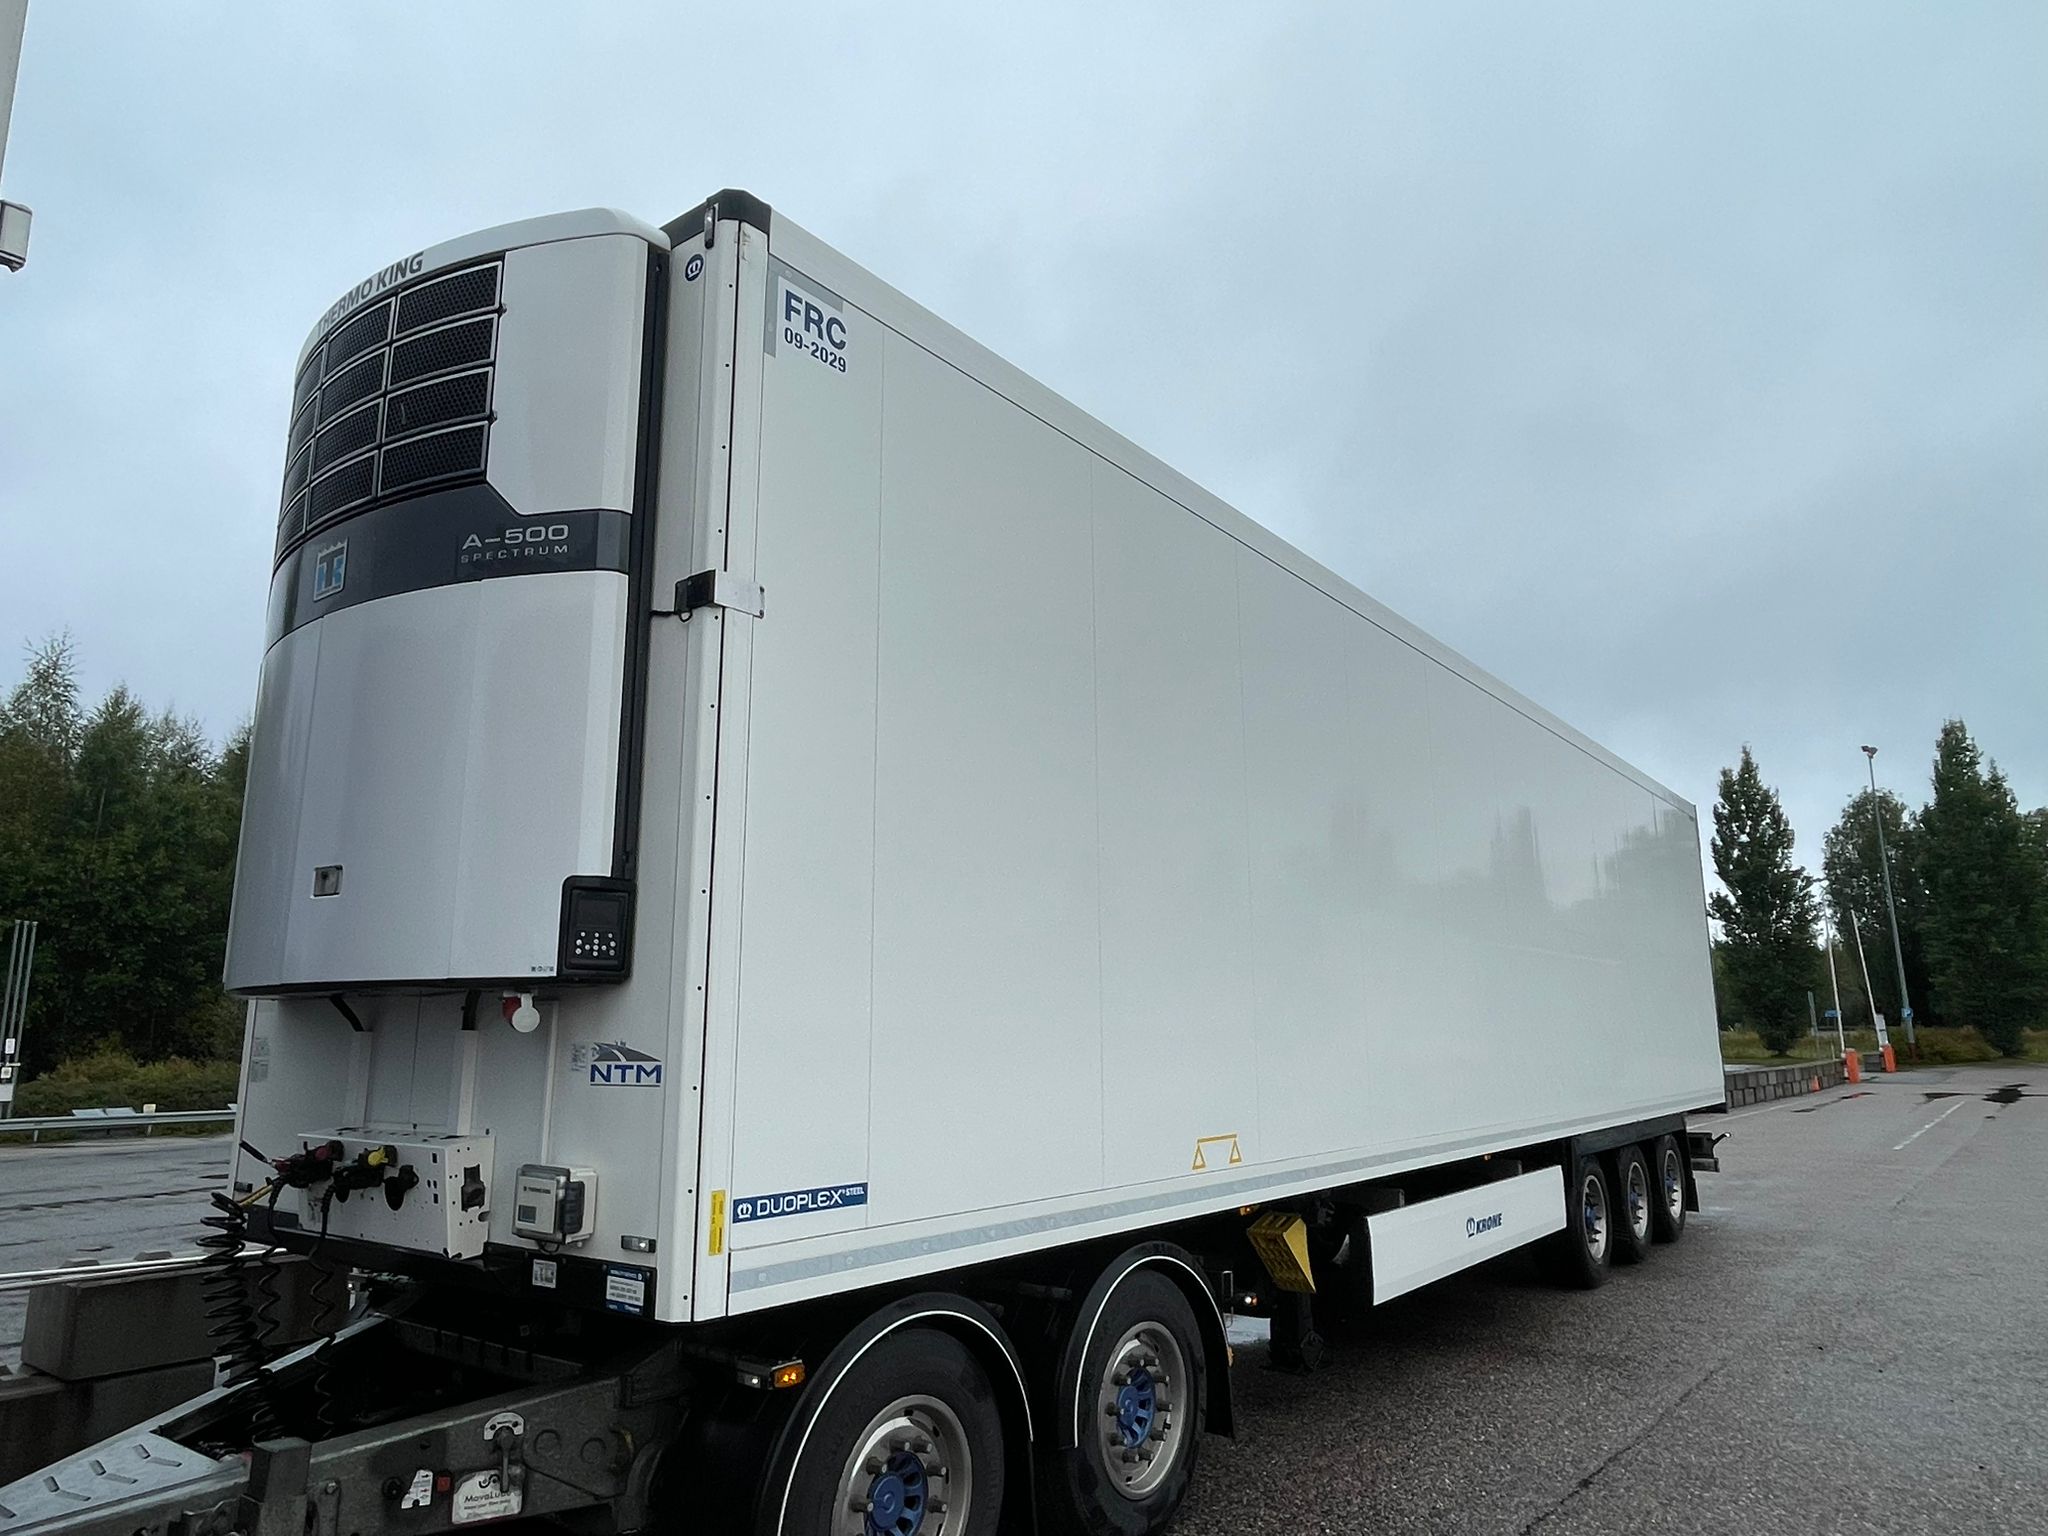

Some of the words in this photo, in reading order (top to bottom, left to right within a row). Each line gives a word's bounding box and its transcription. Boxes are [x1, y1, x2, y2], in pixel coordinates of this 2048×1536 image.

[319, 278, 373, 336] THERMO
[376, 250, 425, 292] KING
[785, 288, 847, 351] FRC
[784, 327, 847, 373] 09-2029
[461, 524, 570, 550] A-500
[460, 544, 569, 564] SPECTRUM
[590, 1064, 662, 1084] NTM
[756, 1188, 843, 1217] DUOPLEX
